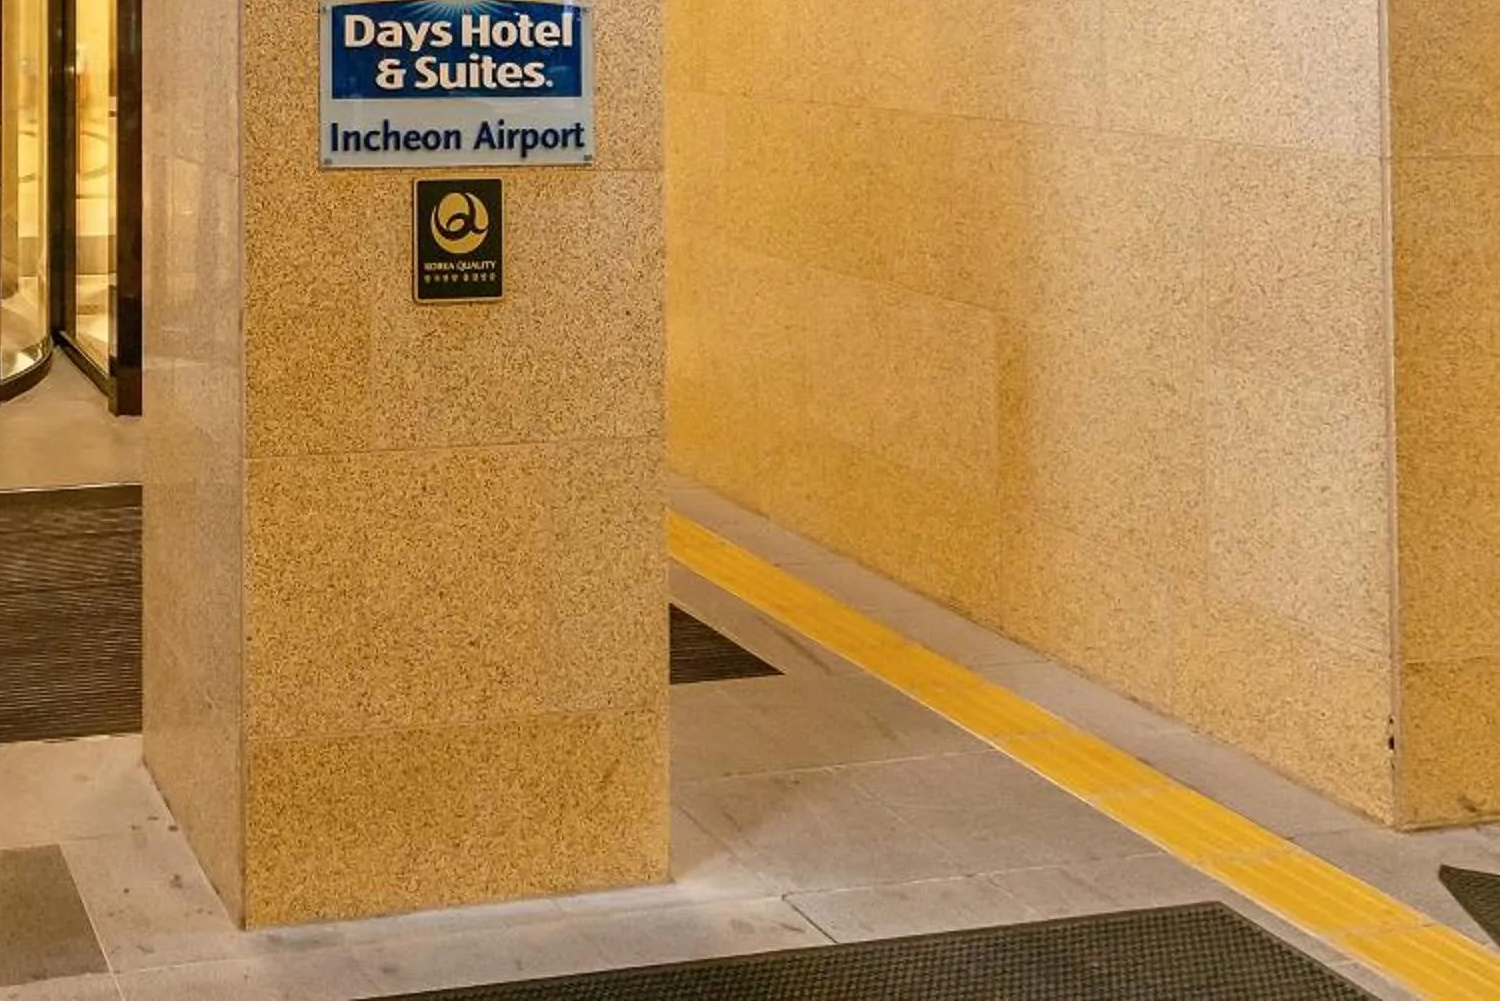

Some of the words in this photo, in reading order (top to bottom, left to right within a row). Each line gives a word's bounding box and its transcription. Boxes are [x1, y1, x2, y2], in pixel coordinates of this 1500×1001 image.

[344, 14, 453, 52] Days
[461, 13, 573, 47] Hotel
[376, 56, 406, 89] &
[331, 119, 461, 152] Incheon
[474, 119, 585, 158] Airport
[456, 260, 497, 271] QUALITY
